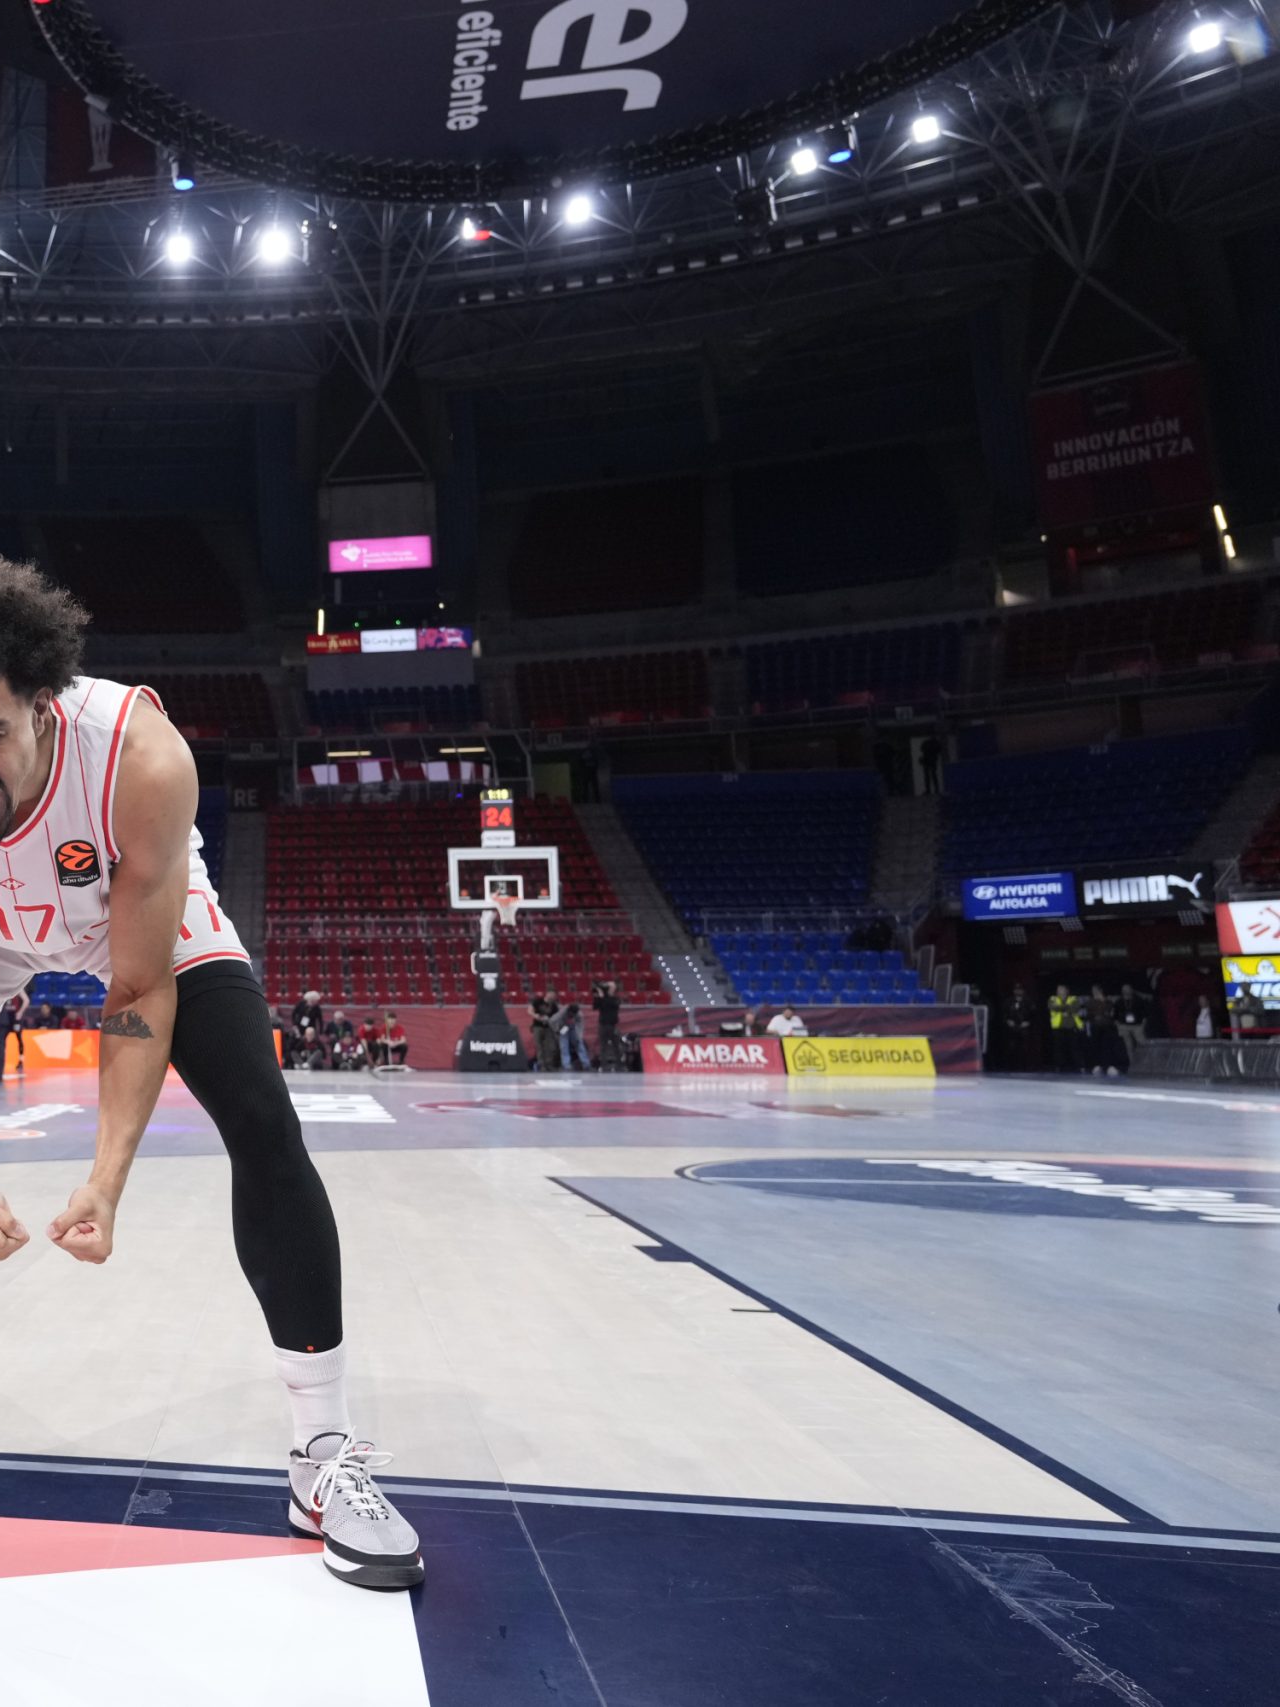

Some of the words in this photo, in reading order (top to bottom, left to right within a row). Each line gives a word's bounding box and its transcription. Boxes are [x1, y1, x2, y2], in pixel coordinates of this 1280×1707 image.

[446, 10, 502, 131] eficiente
[1053, 416, 1181, 458] INNOVACIÓN
[1046, 436, 1194, 480] BERRIHUNTZA
[485, 806, 512, 827] 24
[999, 883, 1062, 897] HYUNDAI
[1084, 875, 1167, 905] PUMA
[989, 897, 1048, 910] AUTOLASA
[677, 1044, 768, 1064] AMBAR
[828, 1049, 925, 1064] SEGURIDAD
